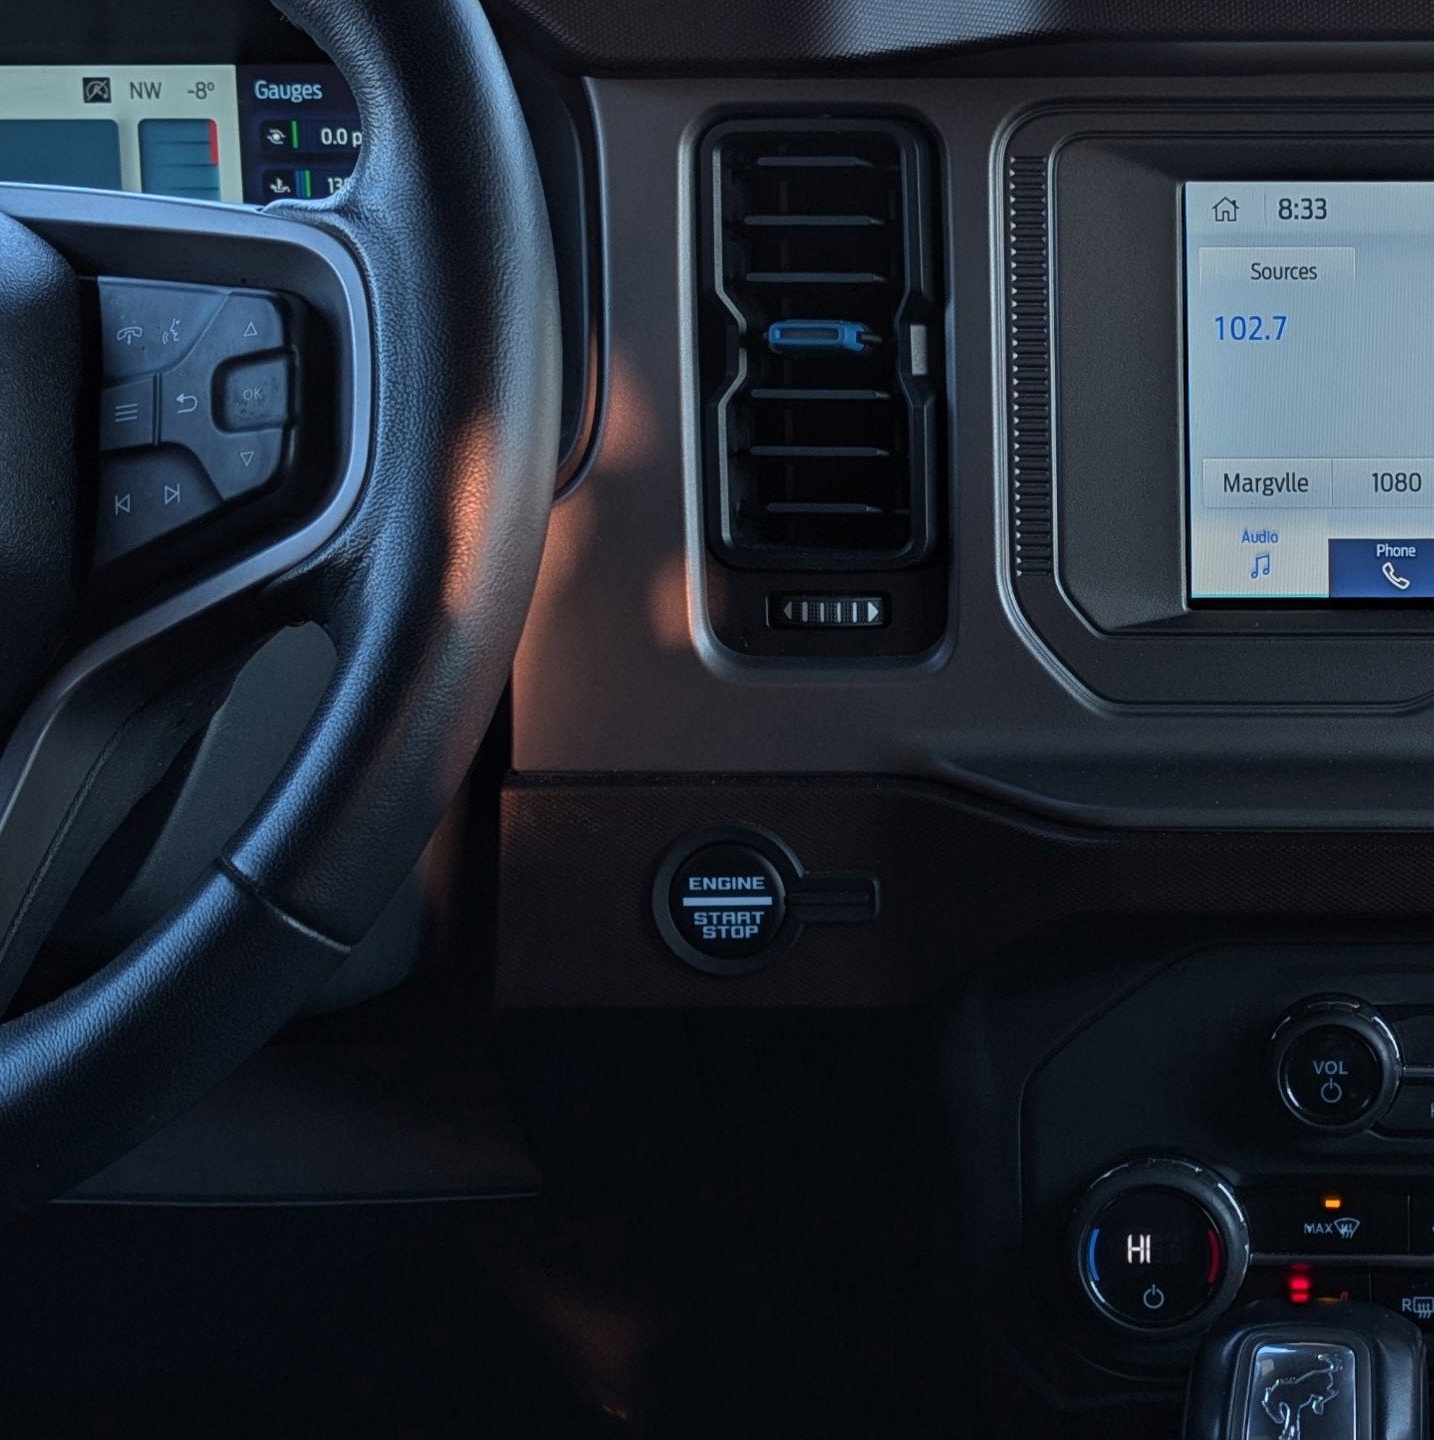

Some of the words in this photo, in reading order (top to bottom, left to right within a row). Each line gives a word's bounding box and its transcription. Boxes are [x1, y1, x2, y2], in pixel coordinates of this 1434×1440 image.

[129, 82, 162, 100] NW
[187, 82, 216, 100] -8°
[254, 80, 323, 103] Gauges
[321, 128, 348, 145] 0.0
[1278, 198, 1328, 220] 8:33
[1250, 262, 1318, 280] Sources
[1215, 315, 1288, 341] 102.7
[242, 387, 263, 401] OK
[1223, 472, 1309, 497] Margvlle
[1371, 472, 1422, 493] 1080
[1241, 530, 1279, 544] Audio
[1376, 544, 1417, 557] Phone
[689, 876, 765, 891] ENGINE
[694, 911, 765, 925] START
[702, 925, 759, 940] STOP
[1313, 1061, 1349, 1076] VOL
[1304, 1222, 1333, 1235] MAX
[1127, 1234, 1152, 1264] HI
[1401, 1297, 1411, 1312] R
